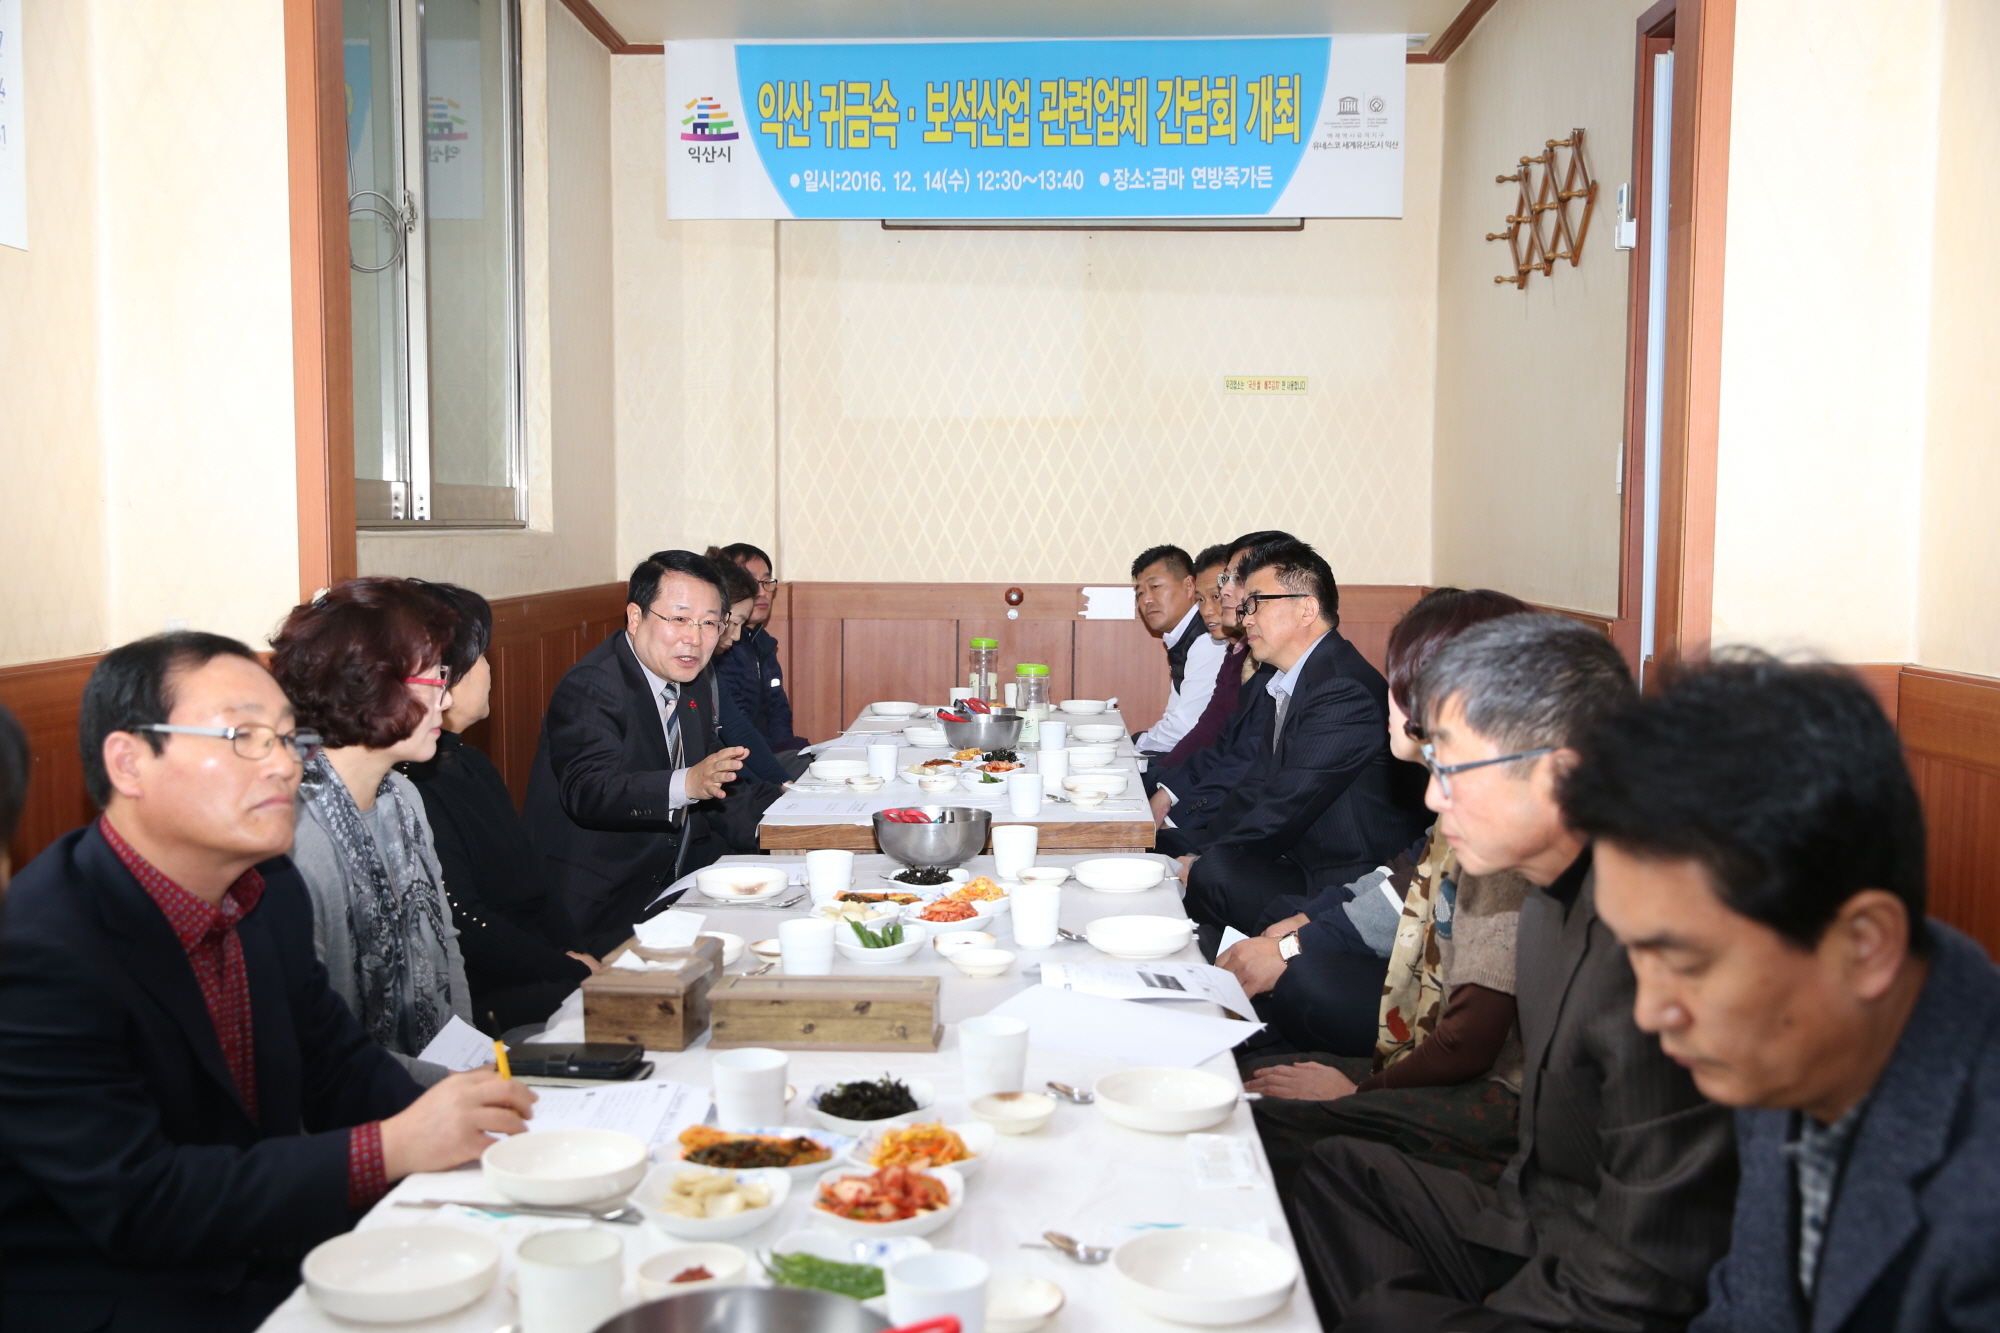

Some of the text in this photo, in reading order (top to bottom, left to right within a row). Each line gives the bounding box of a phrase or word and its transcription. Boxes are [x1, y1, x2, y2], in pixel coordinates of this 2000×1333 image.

[758, 80, 813, 149] 익산
[819, 79, 900, 149] 귀금속
[923, 78, 1031, 148] 보석산업
[1039, 76, 1149, 147] 관련업체
[1156, 75, 1238, 145] 간담회
[1245, 74, 1301, 144] 개최
[688, 145, 731, 163] 익산시
[1312, 141, 1341, 150] 유네스코
[1384, 140, 1399, 149] 익산
[803, 168, 1085, 194] 일시:2016. 12. 14(수) 12:30~13:40
[1113, 165, 1274, 191] 장소:금마 연방죽가든
